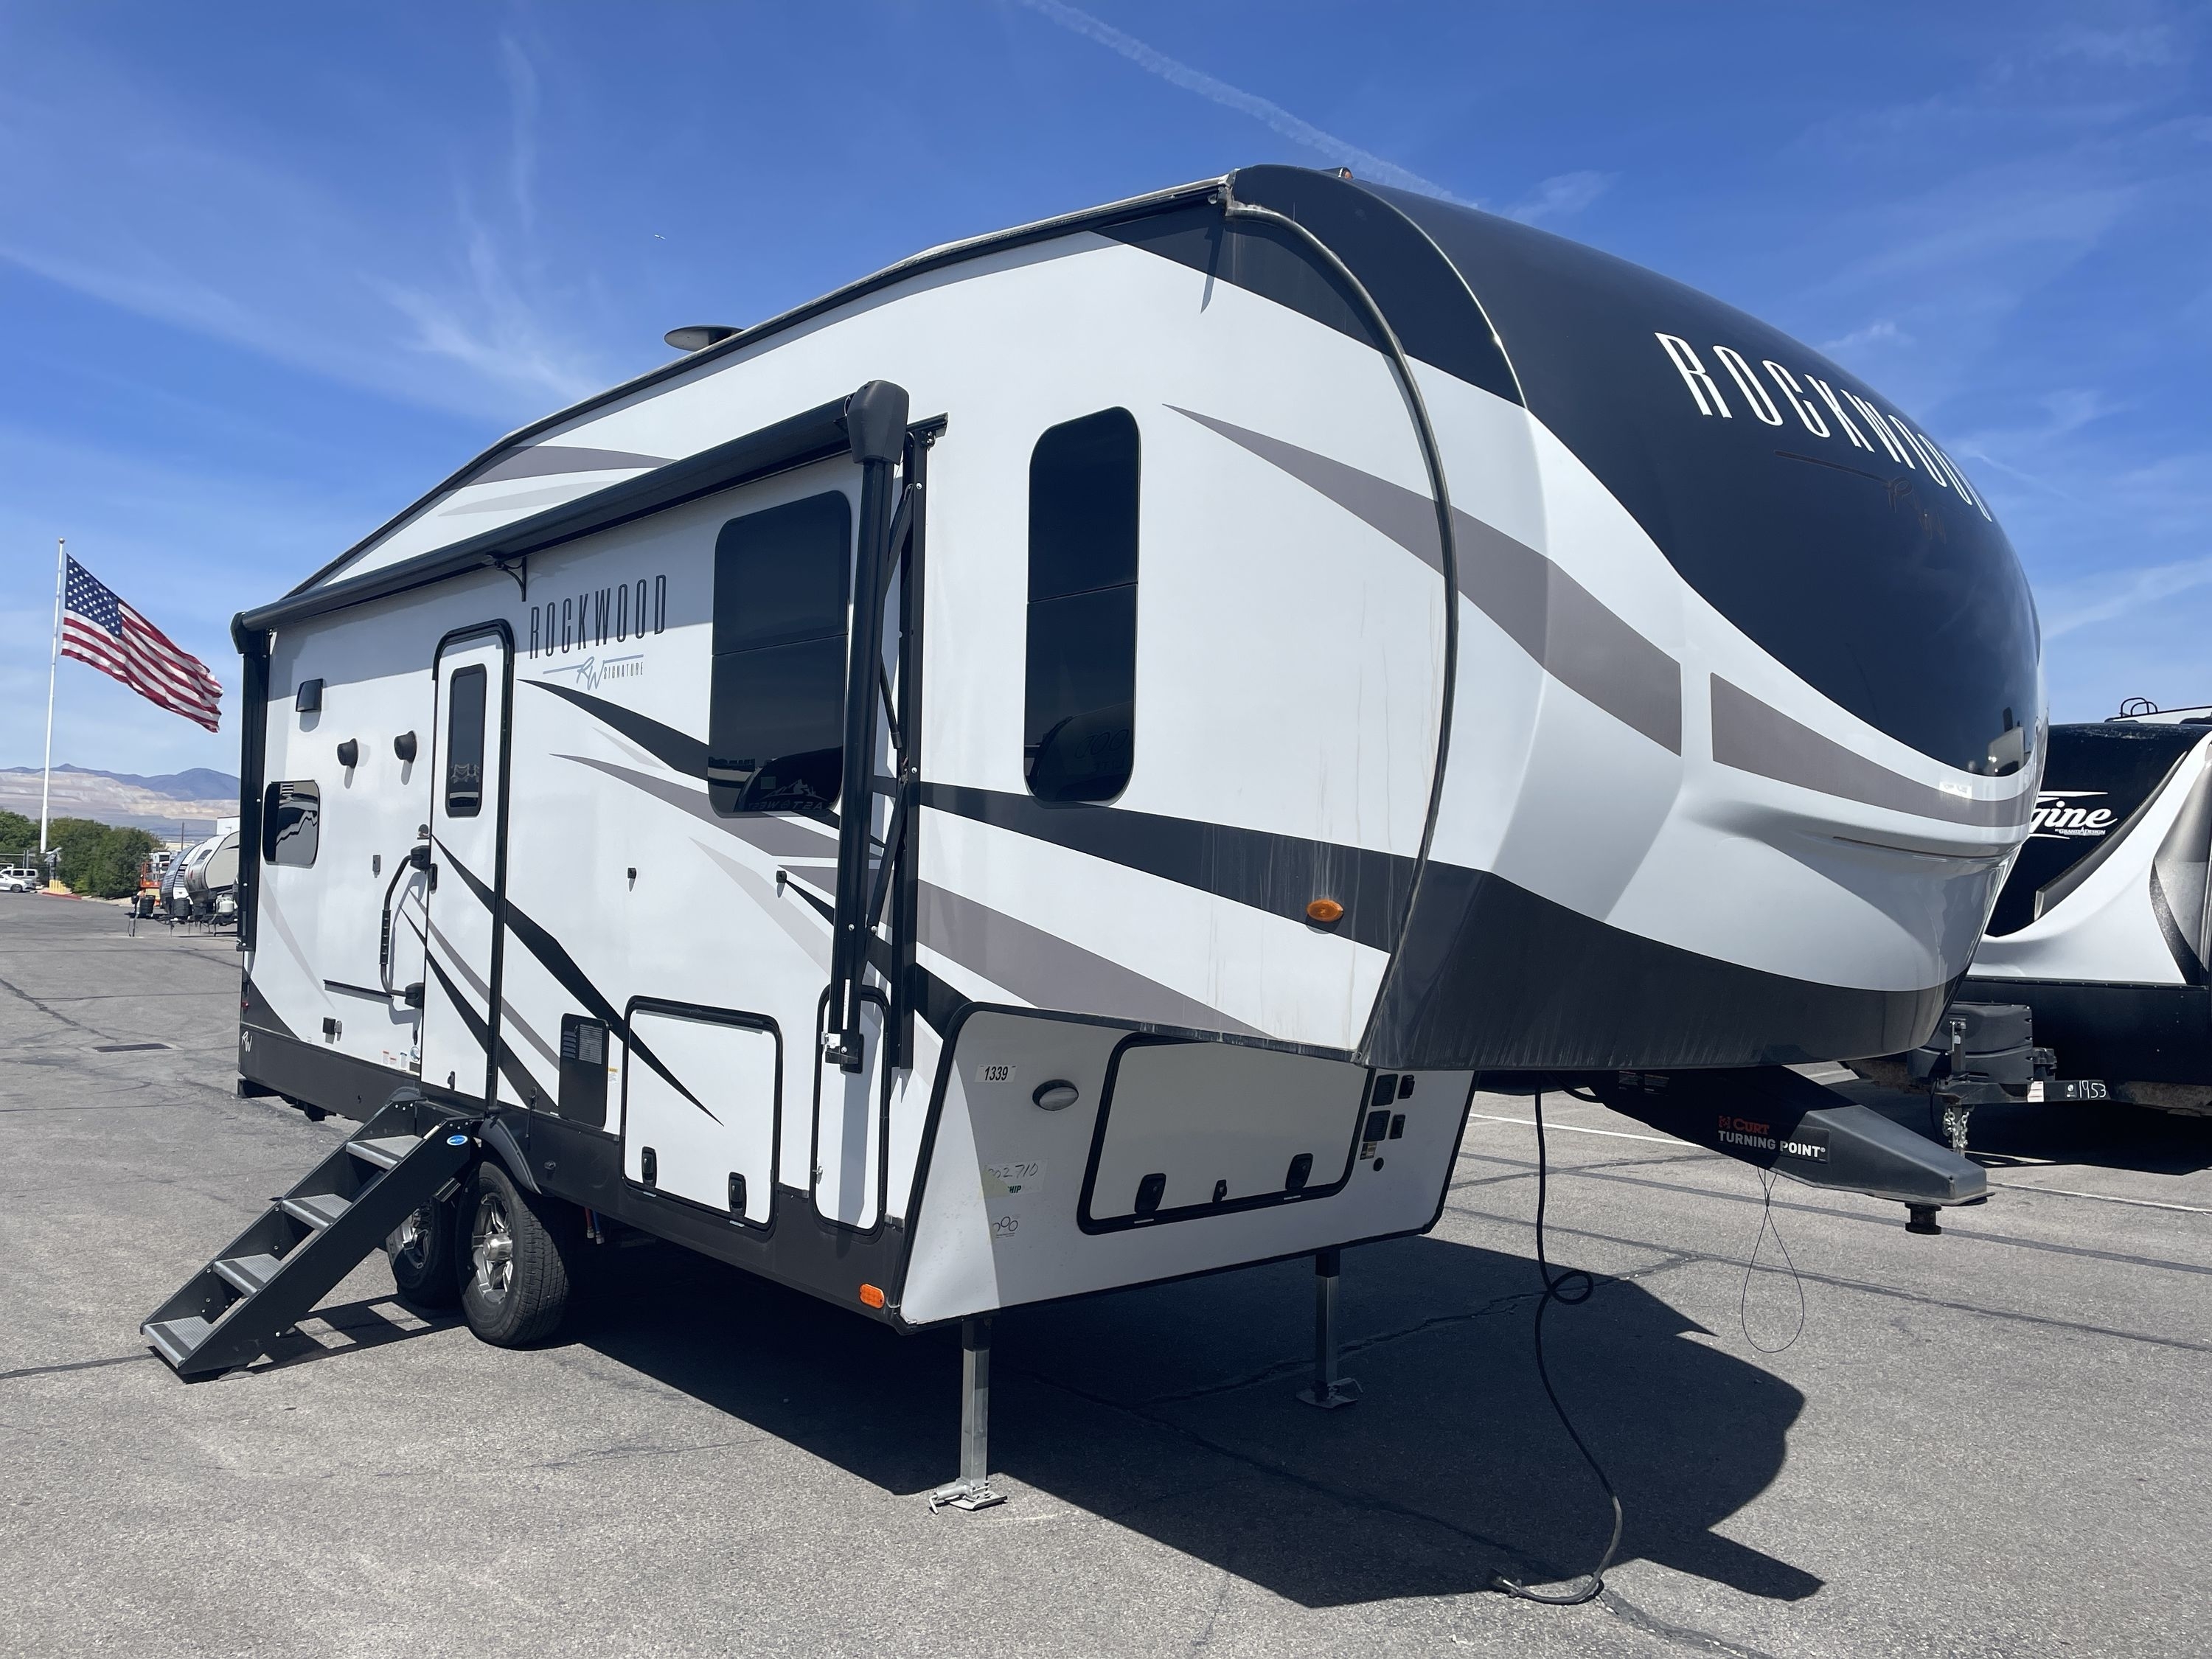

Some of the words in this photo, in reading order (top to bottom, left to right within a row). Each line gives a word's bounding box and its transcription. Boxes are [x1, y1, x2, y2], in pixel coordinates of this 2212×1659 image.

[529, 574, 667, 660] ROCKWOOD
[603, 661, 644, 680] SIGNATURE
[2028, 800, 2118, 834] gine
[984, 1065, 1009, 1082] 1339
[2079, 1080, 2107, 1099] 1953
[1733, 1118, 1770, 1135] CURT
[1718, 1130, 1776, 1150] TURNING
[1007, 1185, 1022, 1194] HIP
